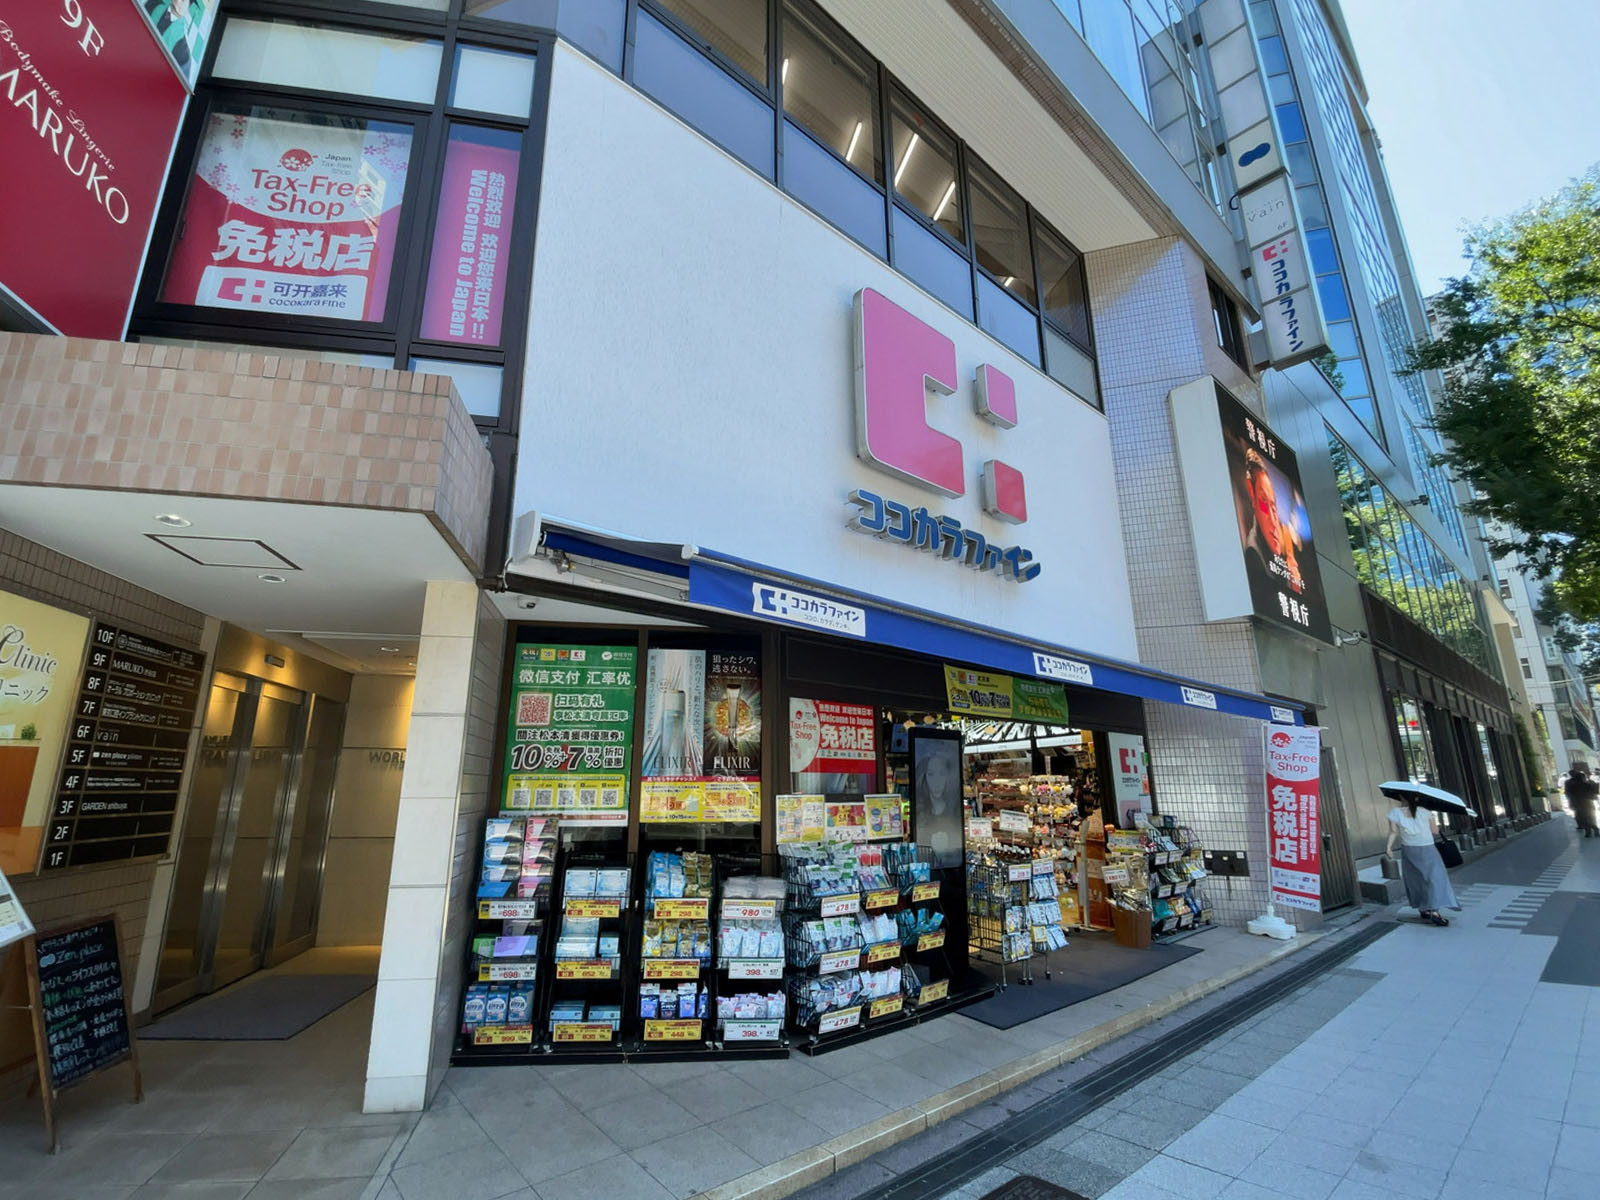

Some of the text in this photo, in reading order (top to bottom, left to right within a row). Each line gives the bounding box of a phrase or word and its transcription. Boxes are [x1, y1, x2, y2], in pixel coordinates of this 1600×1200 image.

[60, 0, 104, 56] 9F
[66, 109, 115, 172] Lingerie
[252, 168, 372, 198] Tax-Free
[267, 192, 345, 221] Shop
[211, 219, 375, 271] 免税店
[449, 169, 488, 337] Welcome to Japan
[273, 281, 348, 299] 可开嘉来
[1271, 258, 1304, 352] ココカラファイン
[1244, 416, 1277, 460] 警視庁
[849, 488, 1041, 583] ココカラファイン
[791, 597, 860, 622] ココカラファイン
[1277, 591, 1310, 628] 警視庁
[97, 629, 114, 644] 10F
[0, 625, 57, 674] Clinic
[93, 653, 106, 666] 9F
[113, 660, 144, 675] MARUKO
[712, 654, 757, 665] 狙ったシワ、
[712, 664, 752, 675] 逃さない。
[87, 676, 101, 690] 8F
[518, 669, 631, 686] 微信支付 汇率优
[83, 700, 96, 714] 7F
[554, 693, 605, 708] 扫码有礼
[77, 725, 90, 738] 6F
[791, 721, 817, 731] Tax-Free
[795, 731, 812, 740] Shop
[820, 724, 874, 750] 免税店
[71, 749, 85, 763] 5F
[604, 745, 625, 757] 折扣
[1269, 750, 1318, 763] Tax-Free
[652, 756, 692, 770] ELIXIR
[713, 756, 751, 770] ELIXIR
[1277, 761, 1308, 774] Shop
[65, 775, 79, 789] 4F
[60, 800, 74, 814] 3F
[81, 802, 106, 811] GARDEN
[1270, 785, 1299, 865] 免税店
[54, 826, 69, 840] 2F
[51, 852, 64, 866] 1F
[502, 909, 518, 918] 698
[741, 908, 760, 917] 980
[835, 903, 850, 913] 478
[834, 959, 849, 969] 478
[502, 970, 519, 979] 698
[834, 1017, 849, 1028] 478
[741, 1030, 758, 1038] 398
